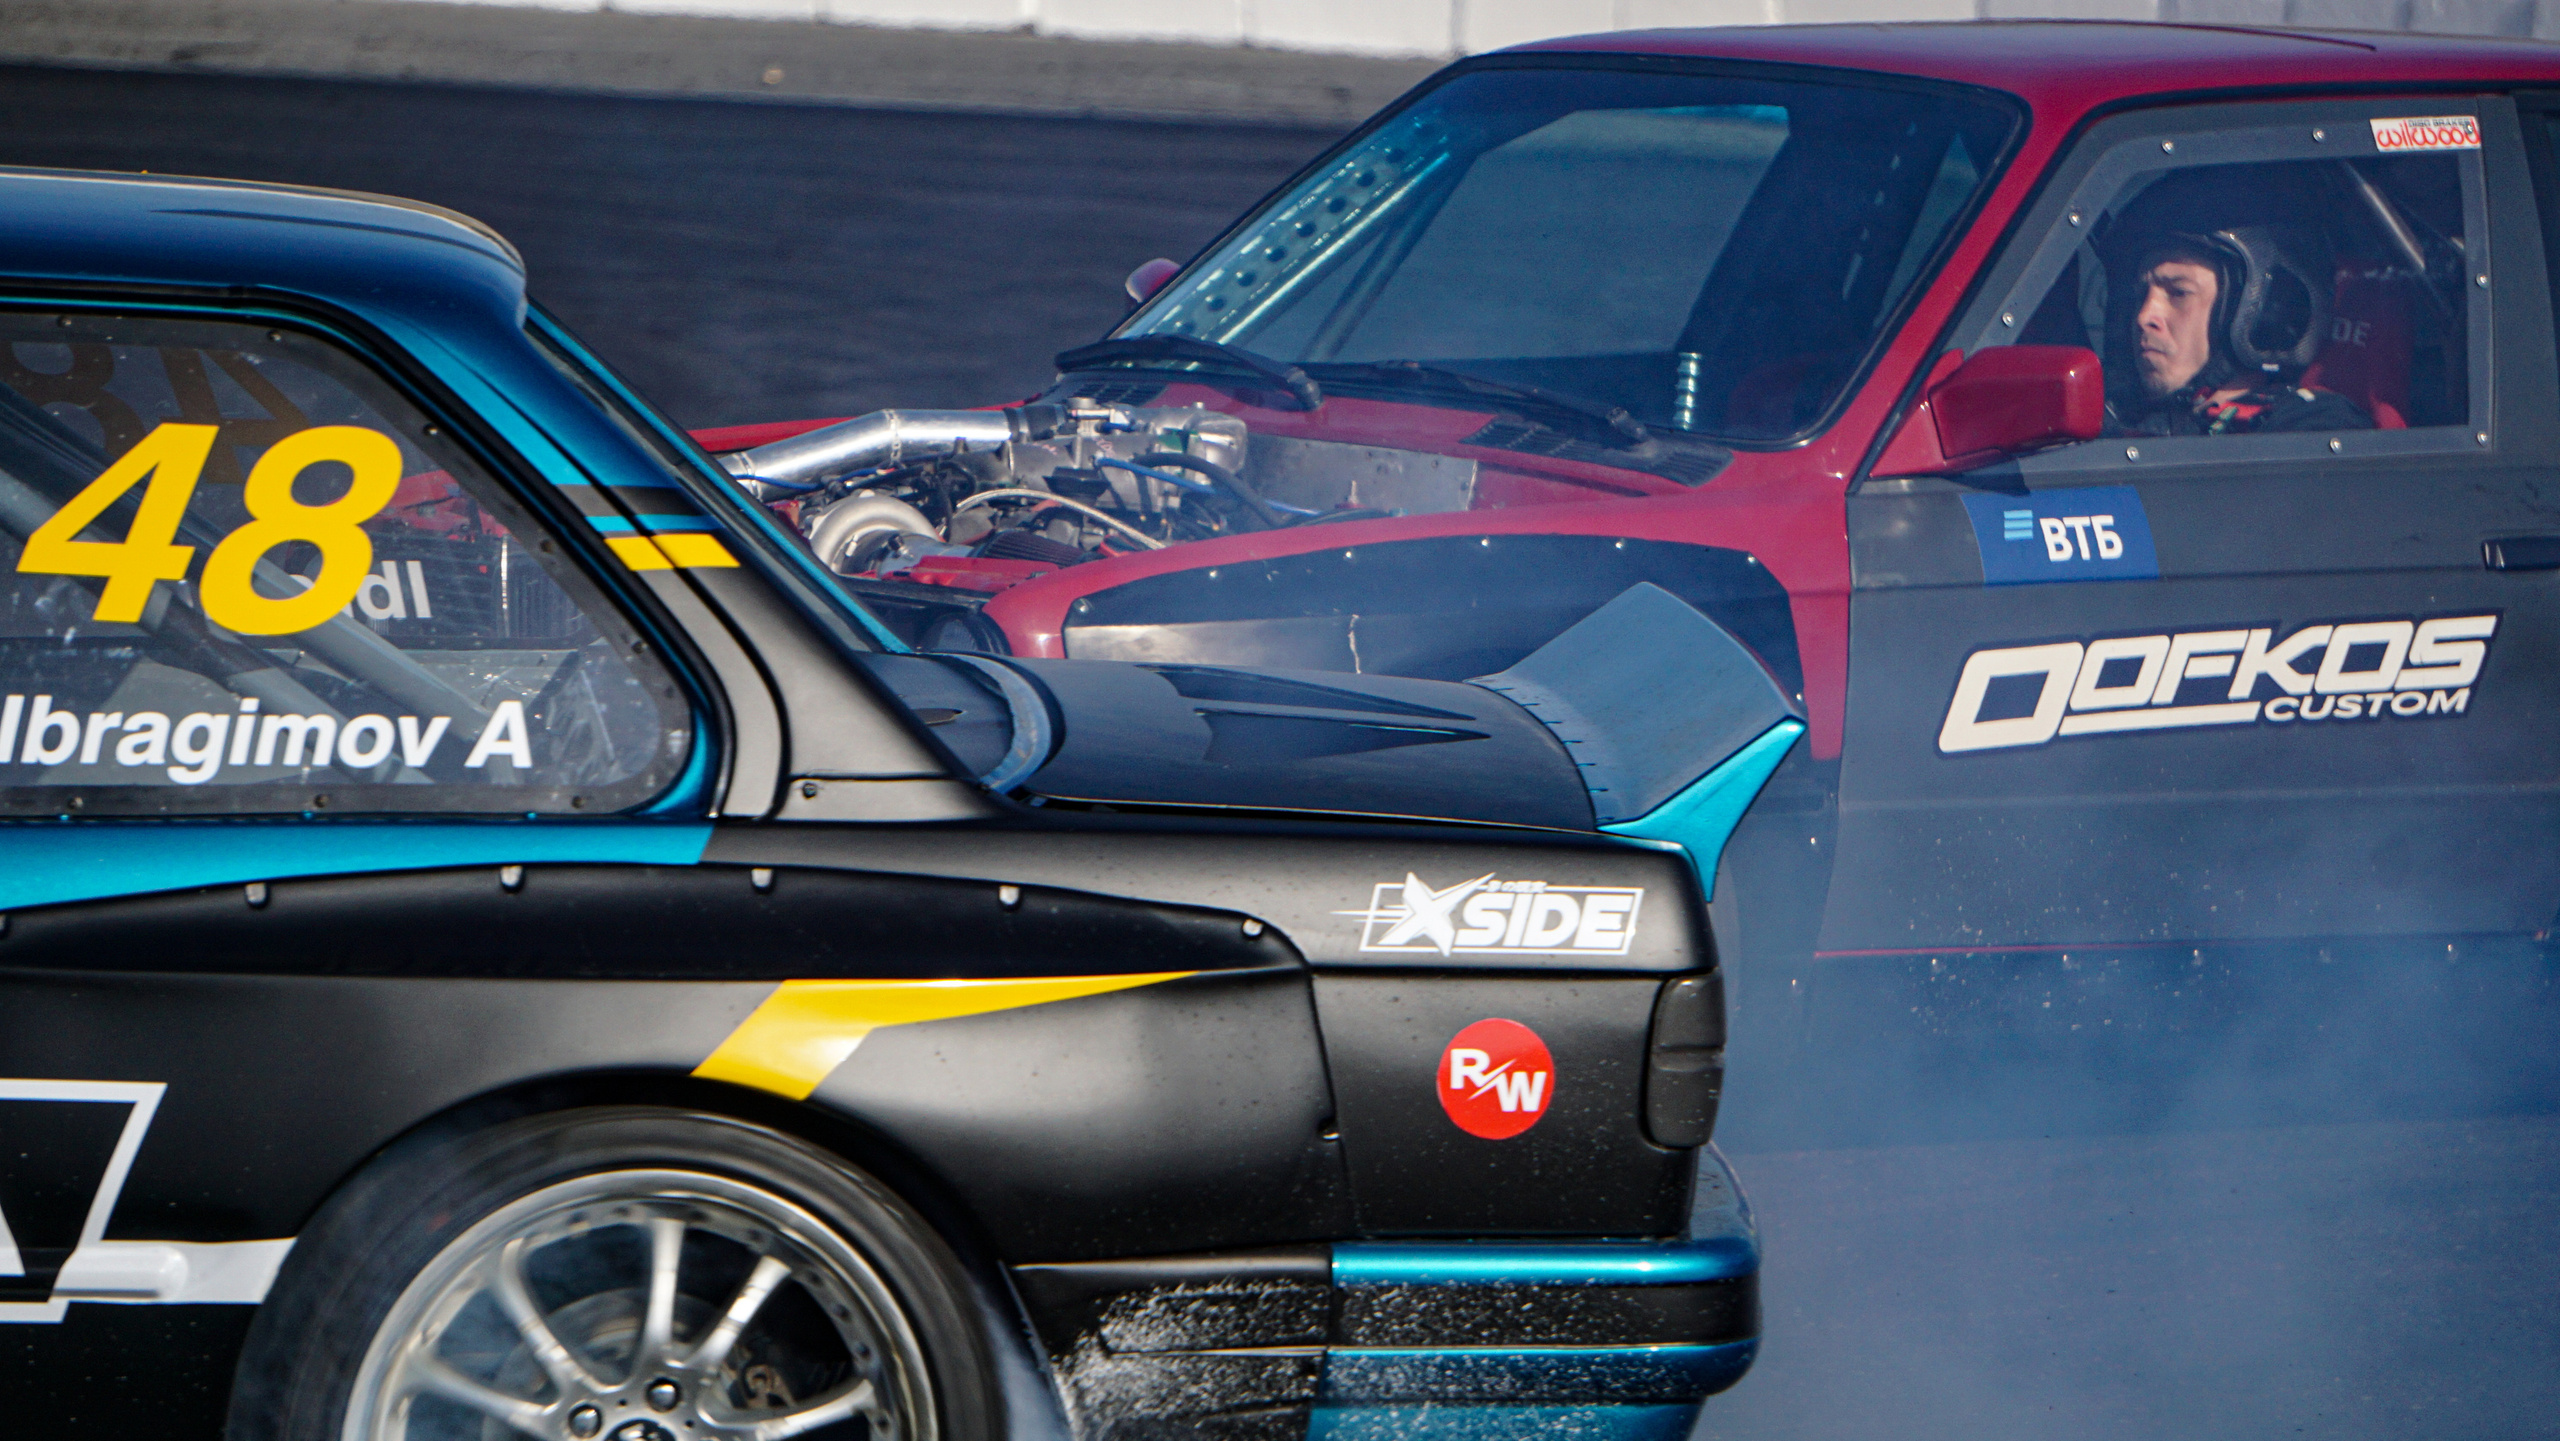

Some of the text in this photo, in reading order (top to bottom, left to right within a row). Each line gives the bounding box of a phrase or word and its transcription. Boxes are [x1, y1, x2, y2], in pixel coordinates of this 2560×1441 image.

[2376, 117, 2480, 148] wilwood
[16, 422, 403, 636] 48
[2040, 514, 2124, 562] ВТБ
[2264, 688, 2470, 722] CUSTOM
[464, 700, 533, 769] A
